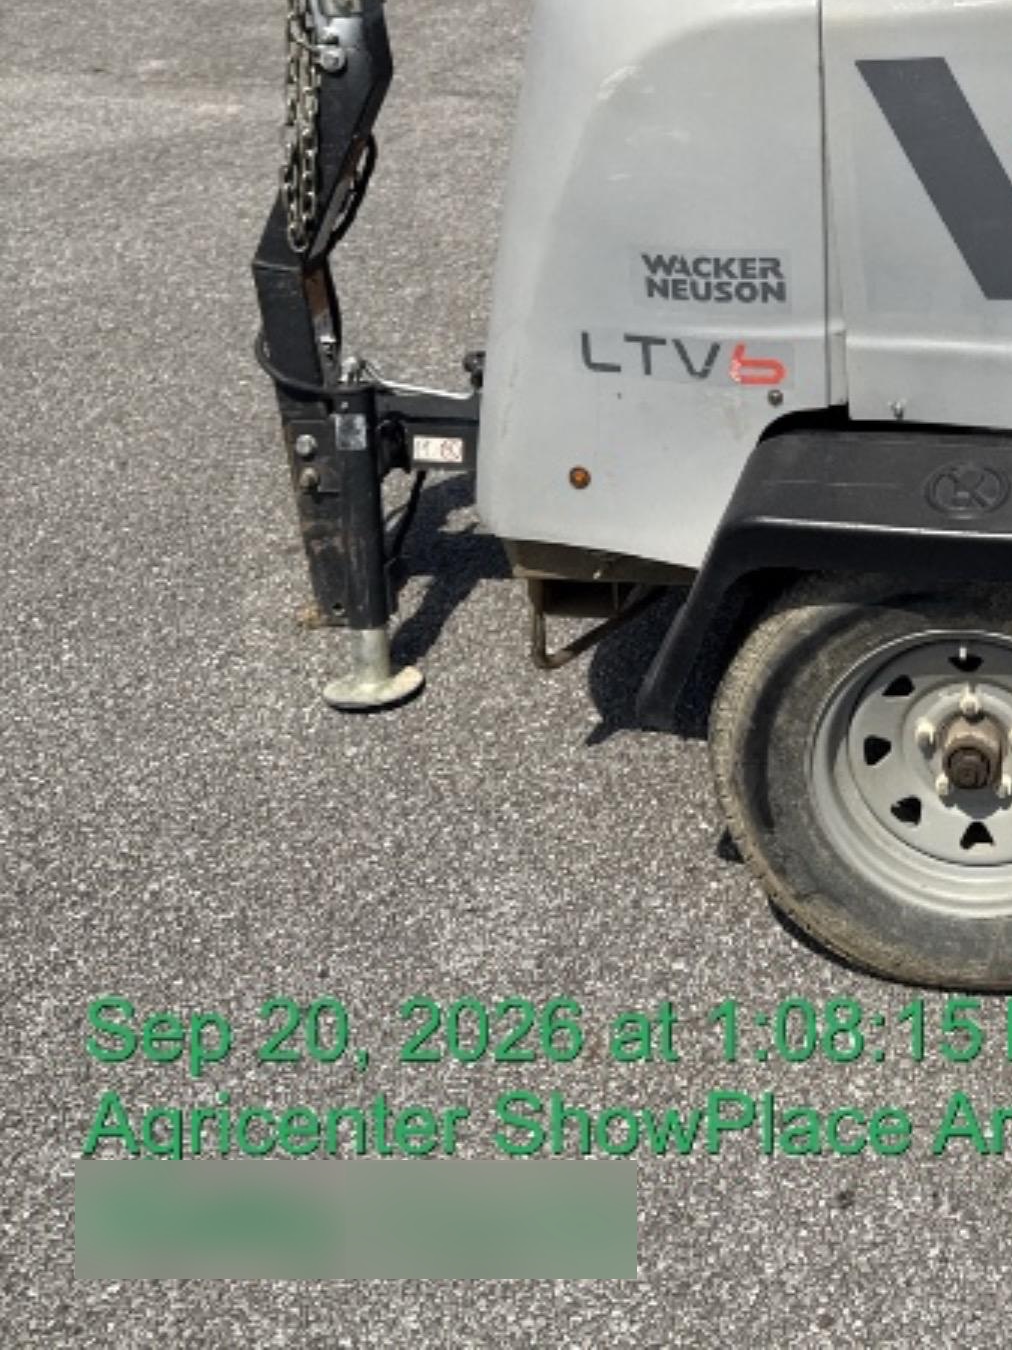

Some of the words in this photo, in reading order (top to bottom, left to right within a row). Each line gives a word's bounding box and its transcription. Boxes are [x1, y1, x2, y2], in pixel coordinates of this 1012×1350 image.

[640, 251, 786, 281] WACKER
[645, 277, 788, 304] NEUSON
[580, 330, 788, 385] LTV6
